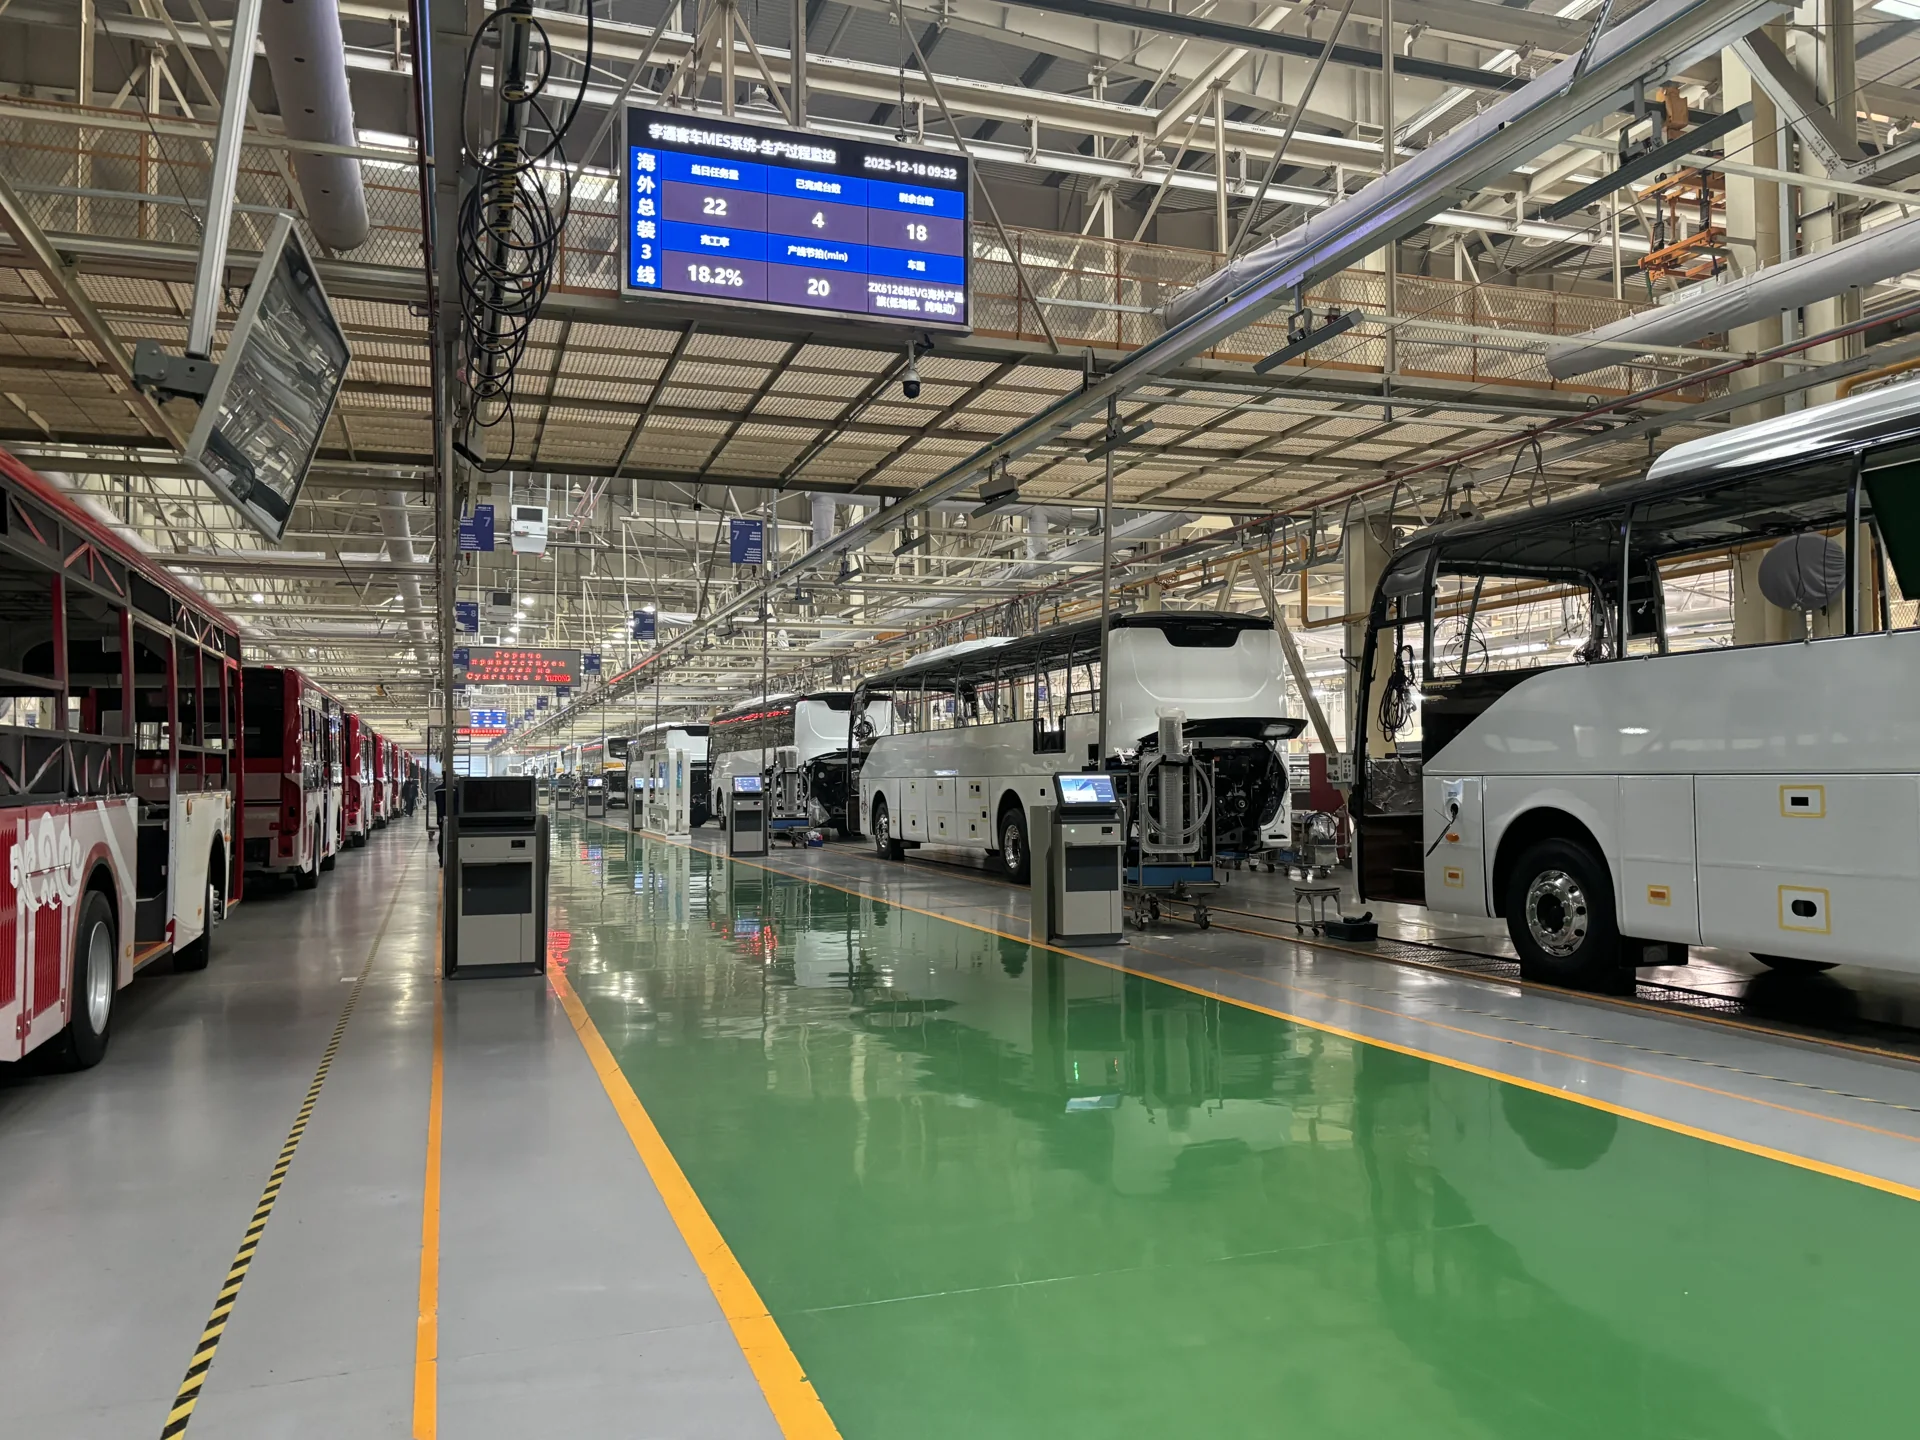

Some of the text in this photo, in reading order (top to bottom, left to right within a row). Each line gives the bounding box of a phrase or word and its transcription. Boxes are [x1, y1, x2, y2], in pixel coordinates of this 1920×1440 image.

[691, 164, 739, 180] 当日任务量
[864, 157, 957, 180] 2025-12-18 09:32
[795, 179, 841, 194] 已完成台数
[703, 197, 727, 216] 22
[812, 211, 826, 228] 4
[906, 224, 928, 242] 18
[688, 264, 744, 287] 18.2%
[807, 278, 831, 297] 20
[483, 516, 491, 528] 7
[732, 530, 740, 540] 7
[470, 658, 565, 668] приветствуем
[495, 650, 541, 660] Горячо
